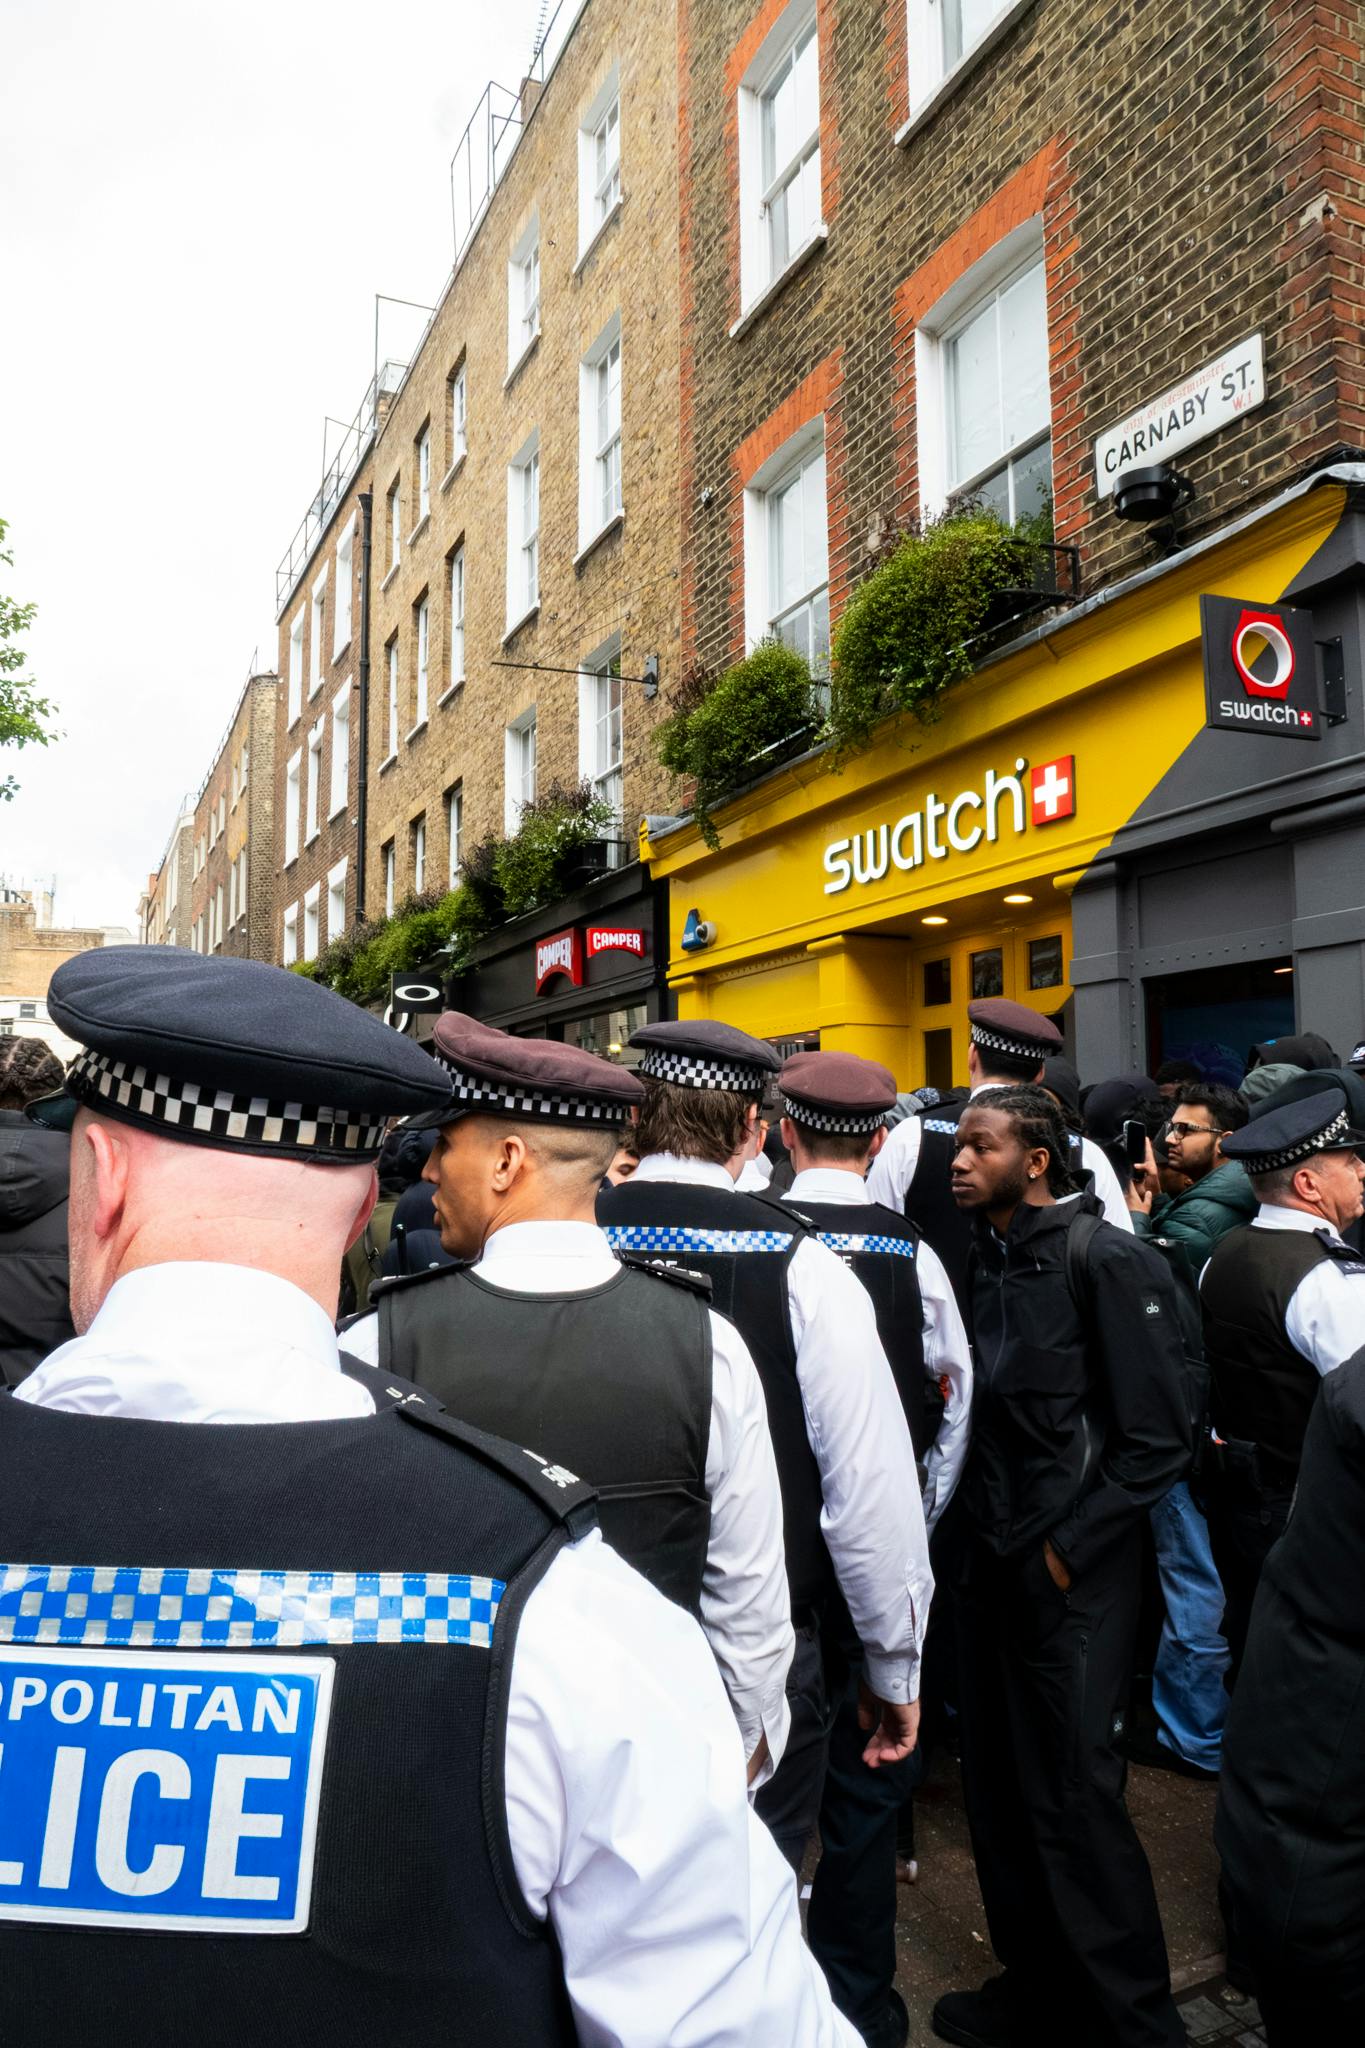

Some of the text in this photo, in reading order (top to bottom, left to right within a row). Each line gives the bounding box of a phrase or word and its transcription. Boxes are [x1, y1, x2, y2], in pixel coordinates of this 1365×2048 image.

[1104, 360, 1255, 473] CARNABY ST.
[1219, 700, 1298, 725] swatch
[823, 766, 1026, 895] swatch
[537, 937, 572, 980] CAMPER
[592, 932, 641, 952] CAMPER
[1146, 1301, 1160, 1314] alo
[0, 1676, 301, 1734] POLITAN
